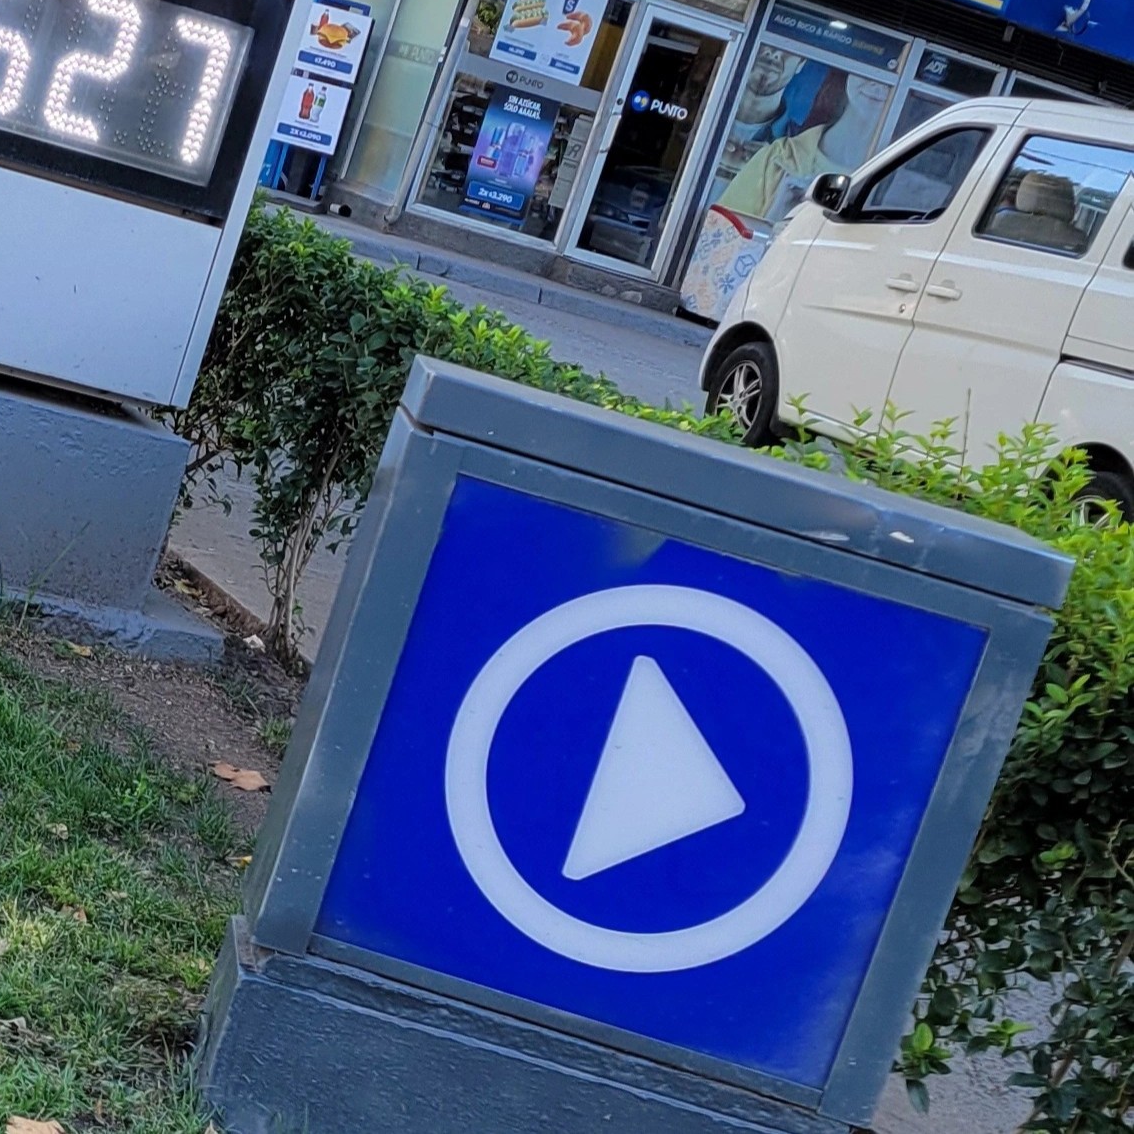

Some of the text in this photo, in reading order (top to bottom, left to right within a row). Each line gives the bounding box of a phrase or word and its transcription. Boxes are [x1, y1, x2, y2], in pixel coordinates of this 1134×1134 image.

[924, 59, 948, 76] ADT
[519, 75, 544, 89] PUNTO
[650, 98, 688, 121] PUNTO
